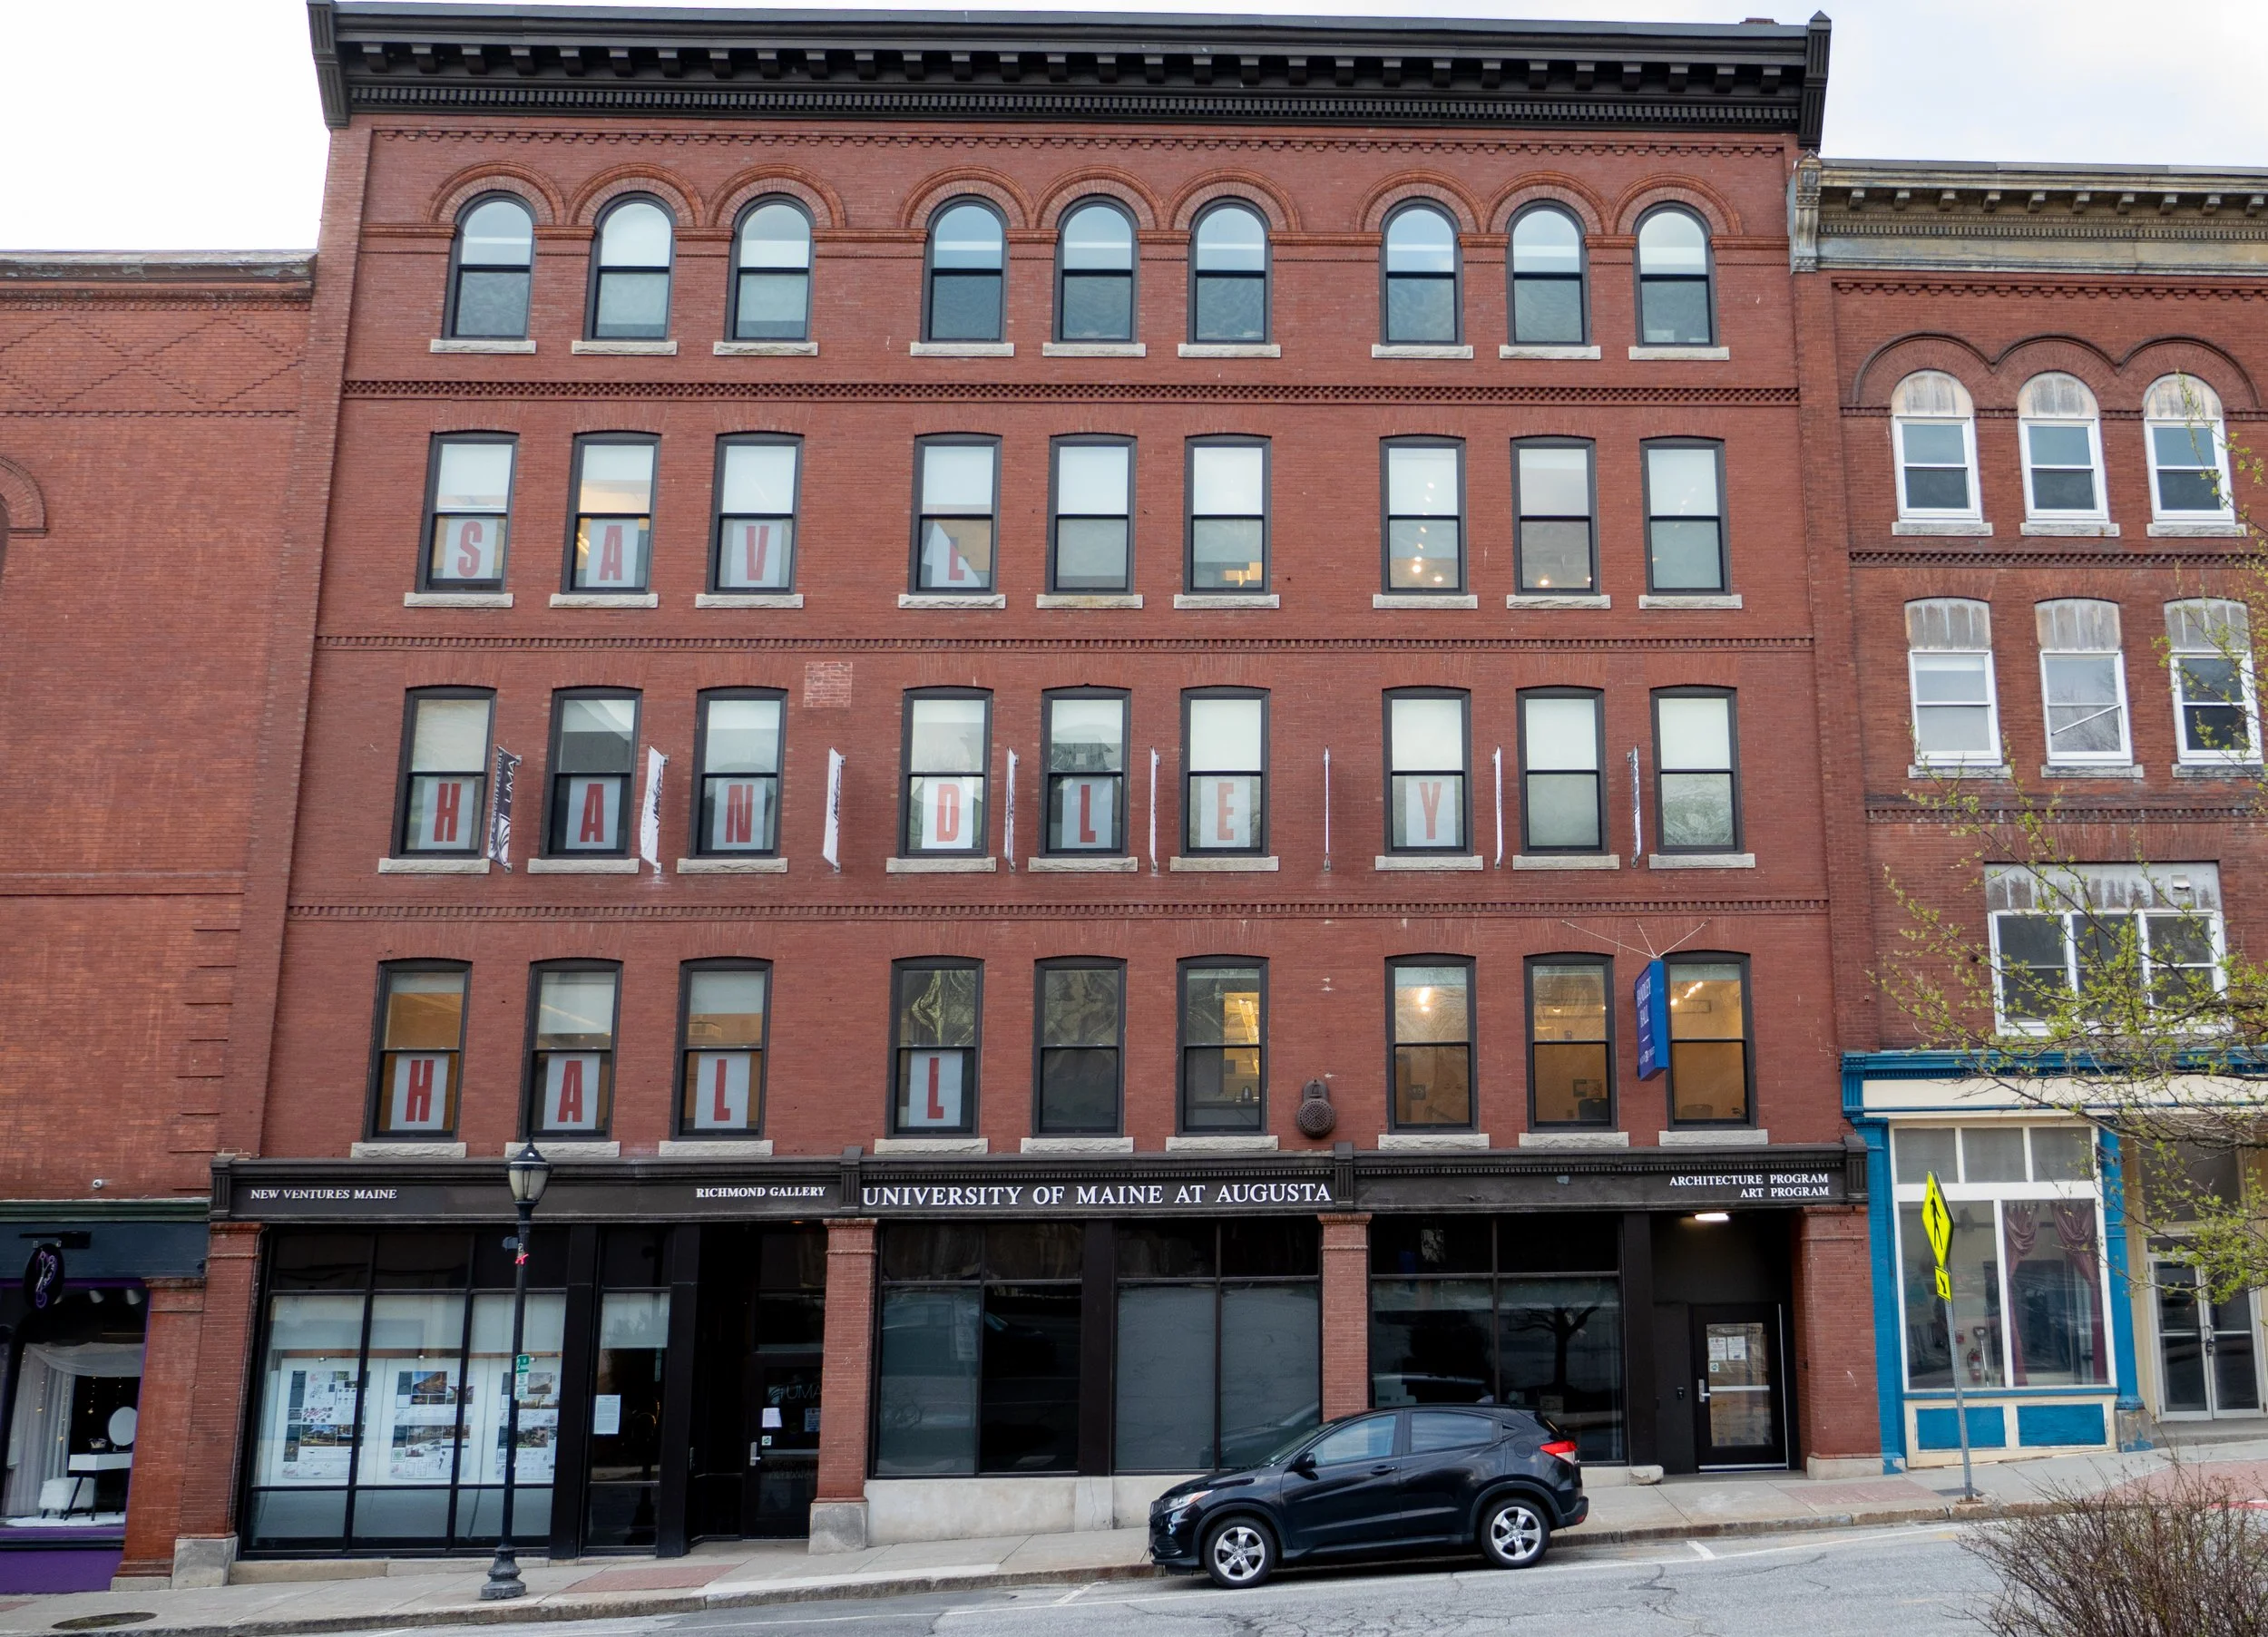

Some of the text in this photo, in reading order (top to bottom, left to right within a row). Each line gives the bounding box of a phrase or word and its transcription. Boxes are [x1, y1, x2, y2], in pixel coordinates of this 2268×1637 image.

[1669, 1174, 1829, 1186] ARCHITECTURE PROGRAM
[250, 1189, 397, 1199] NEW VENTURES MAINE
[696, 1186, 826, 1198] RICHMOND GALLERY
[862, 1183, 1332, 1206] UNIVERSITY OF MAINE AT AUGUSTA
[1740, 1186, 1830, 1198] ART PROGRAM
